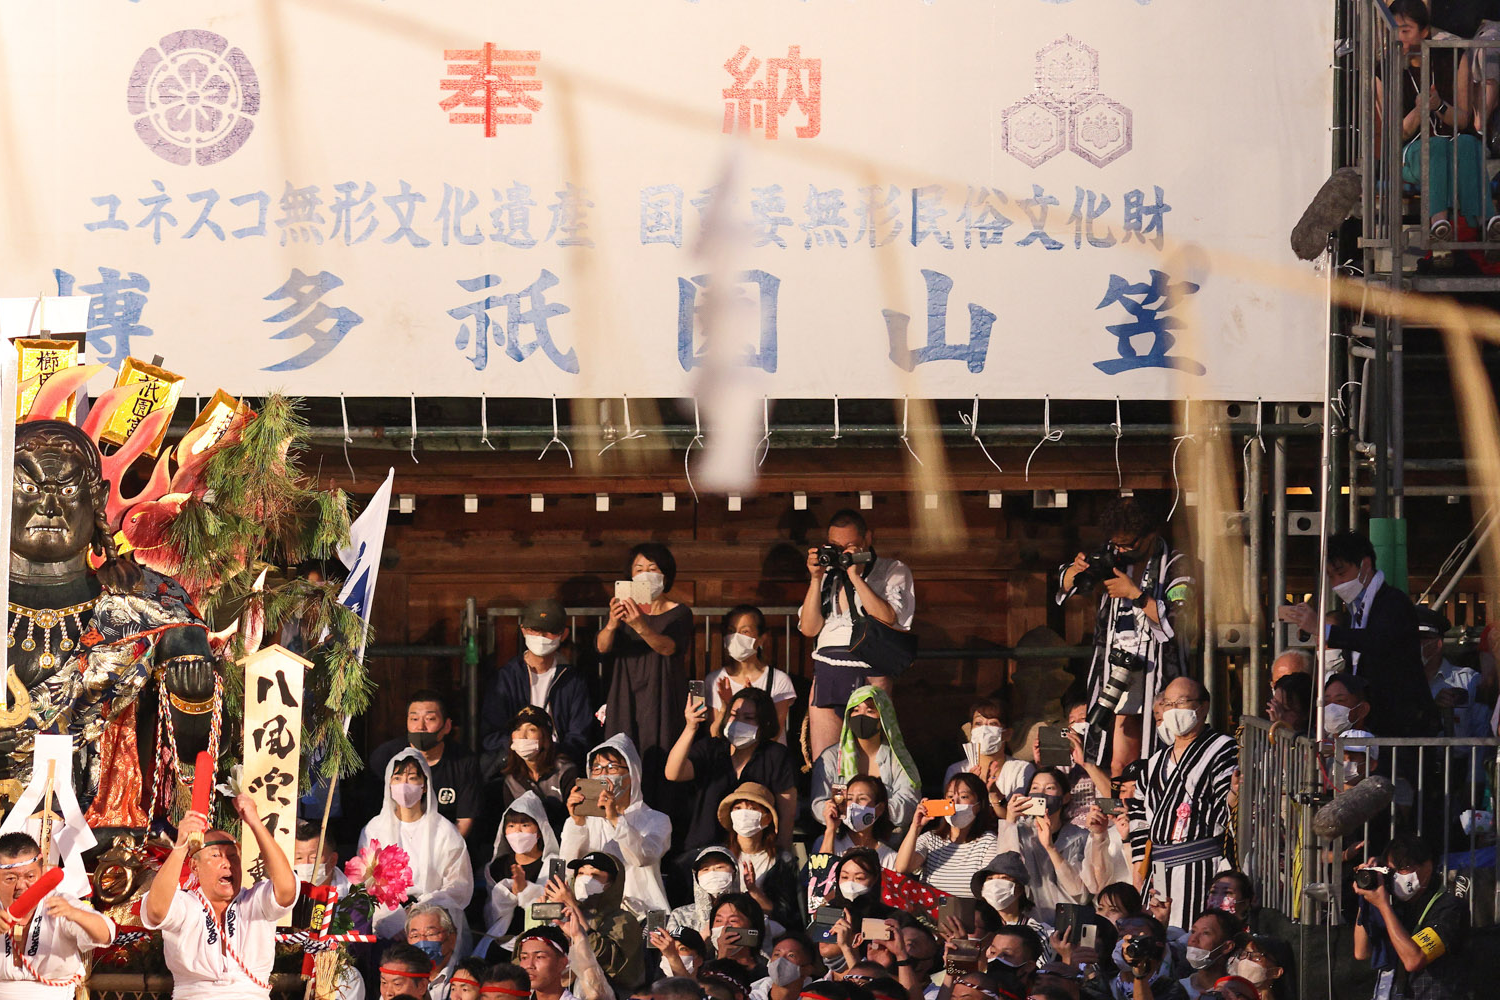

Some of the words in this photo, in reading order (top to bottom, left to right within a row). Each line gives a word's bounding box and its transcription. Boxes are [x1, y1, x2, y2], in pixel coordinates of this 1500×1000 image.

[438, 41, 822, 140] 奉納
[83, 180, 597, 250] ユネスコ無形文化遺産
